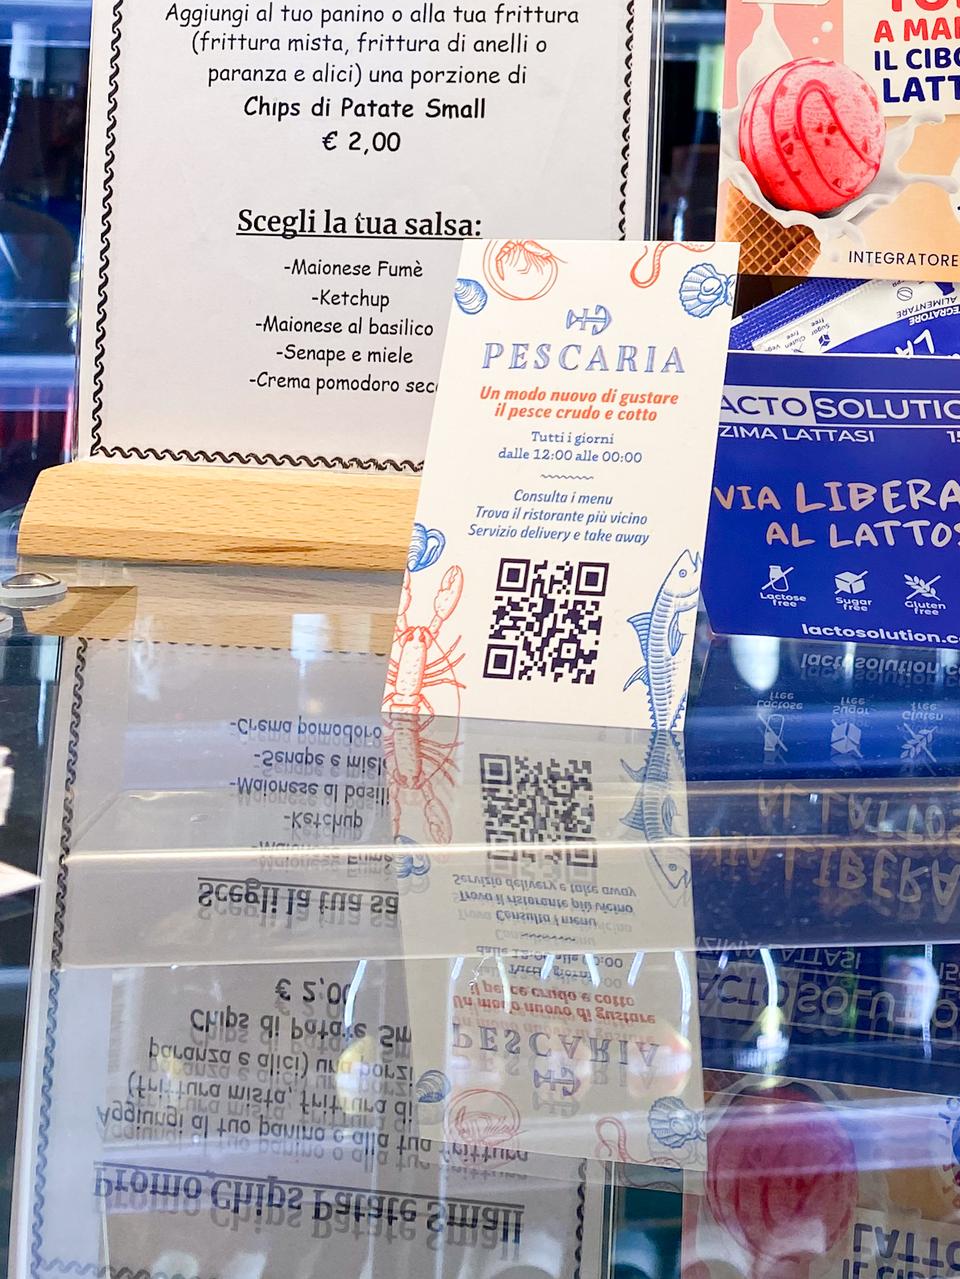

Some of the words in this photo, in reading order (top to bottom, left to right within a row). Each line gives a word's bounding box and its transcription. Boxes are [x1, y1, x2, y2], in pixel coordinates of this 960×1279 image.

[165, 3, 249, 27] Aggiungi
[256, 2, 272, 22] al
[281, 5, 313, 22] tuo
[321, 4, 384, 28] panino
[392, 10, 402, 22] o
[410, 3, 445, 23] alla
[453, 4, 487, 23] tua
[494, 3, 579, 24] frittura
[874, 20, 894, 43] A
[874, 50, 898, 71] IL
[244, 95, 300, 122] Chips
[311, 96, 330, 116] di
[341, 97, 414, 118] Patate
[425, 98, 485, 119] Small
[322, 130, 338, 151] €
[349, 131, 401, 155] 2,00
[237, 209, 316, 239] Scegli
[323, 209, 347, 233] la
[355, 212, 397, 234] tua
[405, 211, 481, 236] salsa:
[284, 259, 371, 276] -Maionese
[378, 260, 423, 277] Fumè
[849, 251, 958, 267] INTEGRATORE
[312, 289, 389, 312] -Ketchup
[896, 295, 958, 318] ALIMENTARE
[256, 315, 342, 333] -Maionese
[348, 317, 362, 334] al
[369, 317, 433, 336] basilico
[276, 344, 346, 367] -Senape
[352, 351, 361, 362] e
[368, 346, 413, 363] miele
[482, 343, 685, 373] PESCARIA
[249, 372, 310, 388] -Crema
[316, 374, 399, 395] pomodoro
[480, 386, 500, 400] Un
[504, 387, 546, 401] modo
[550, 392, 597, 402] nuovo
[601, 388, 617, 403] di
[619, 392, 678, 407] gustare
[495, 403, 506, 416] il
[507, 408, 552, 420] pesce
[556, 405, 600, 419] crudo
[605, 410, 613, 420] e
[618, 409, 657, 421] cotto
[532, 431, 564, 442] Tutti
[567, 432, 571, 442] i
[574, 433, 614, 446] giorni
[718, 427, 777, 441] ZIMA
[782, 428, 874, 442] LATTASI
[498, 447, 529, 459] dalle
[534, 449, 572, 460] 12:00
[575, 450, 598, 462] alle
[602, 451, 642, 463] 00:00
[514, 489, 568, 503] Consulta
[571, 492, 576, 503] i
[578, 495, 613, 504] menu
[713, 484, 782, 511] VIA
[476, 506, 509, 518] Trova
[512, 507, 521, 519] il
[523, 508, 584, 522] ristorante
[586, 511, 607, 525] più
[611, 512, 647, 525] vicino
[468, 524, 517, 537] Servizio
[520, 526, 571, 542] delivery
[574, 532, 580, 540] e
[584, 529, 612, 542] take
[615, 534, 649, 546] away
[766, 522, 815, 547] AL
[760, 592, 806, 603] Lactose
[772, 599, 797, 608] free
[836, 596, 872, 607] Sugar
[843, 602, 868, 612] free
[904, 600, 946, 610] Gluten
[914, 607, 939, 616] free
